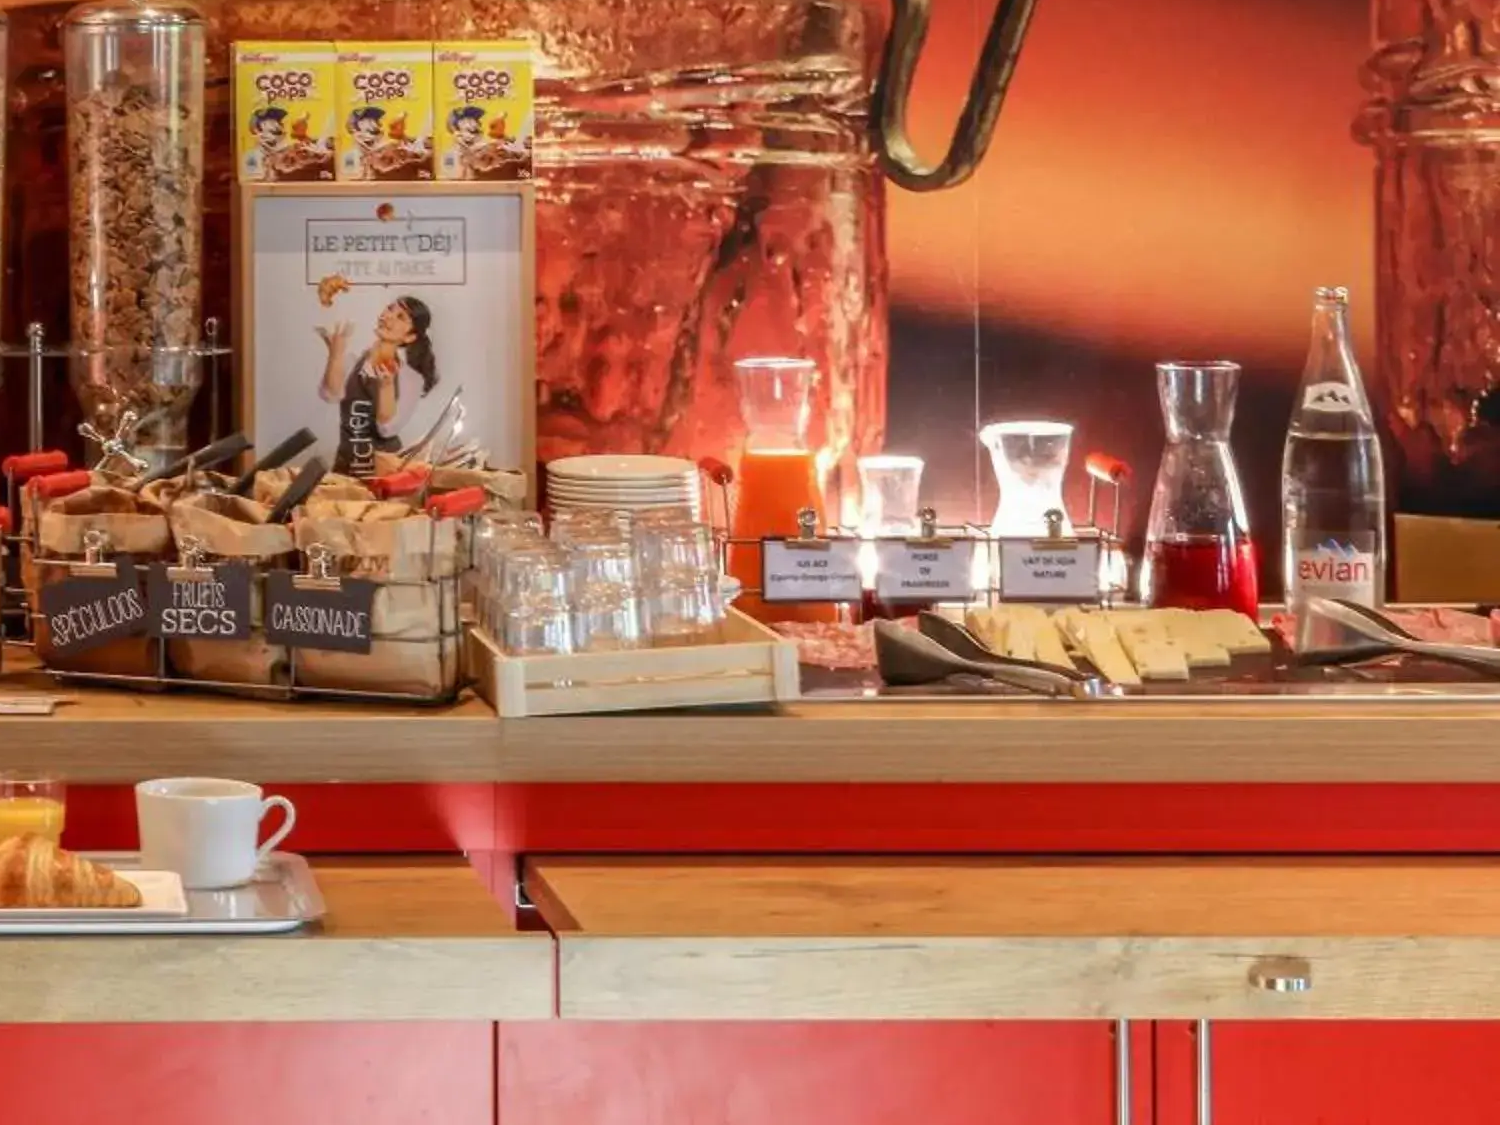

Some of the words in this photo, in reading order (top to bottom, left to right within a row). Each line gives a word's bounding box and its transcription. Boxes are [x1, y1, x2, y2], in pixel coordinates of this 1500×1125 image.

[255, 71, 312, 92] COCO
[353, 70, 410, 90] COCO
[453, 69, 511, 90] COCO
[312, 235, 339, 253] LE
[344, 234, 399, 253] PETIT
[1298, 556, 1368, 582] evian
[160, 608, 236, 635] SECS
[271, 602, 367, 638] CASSONADE
